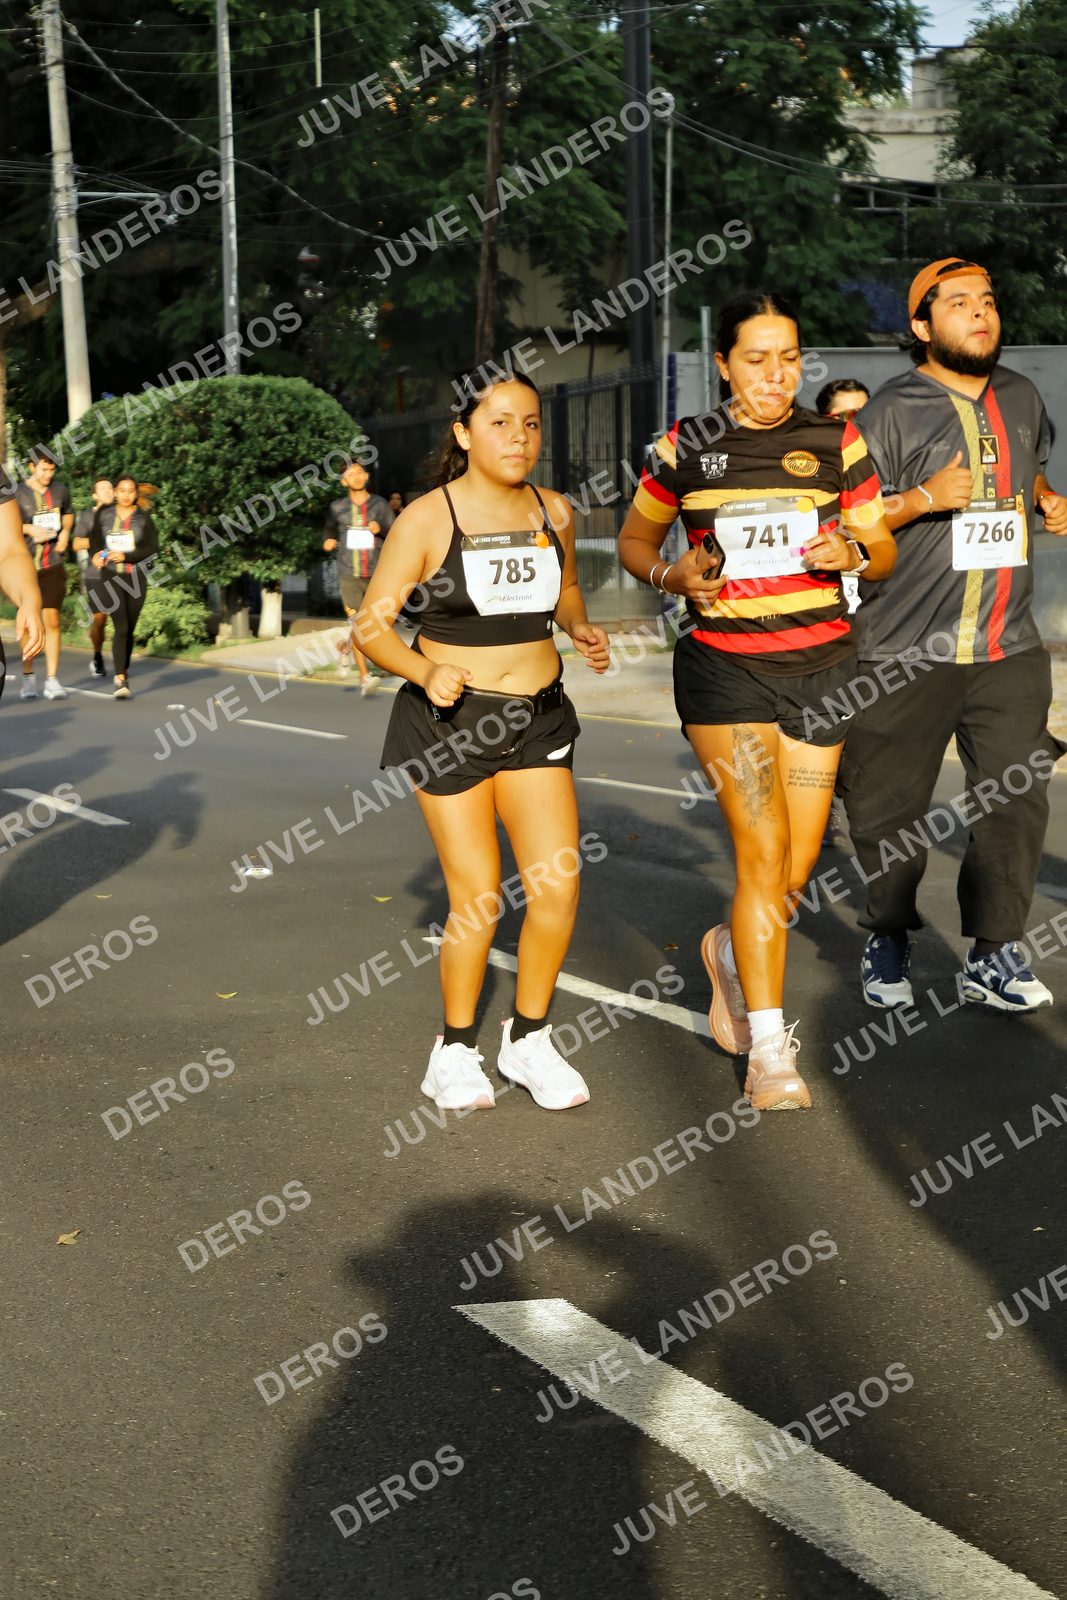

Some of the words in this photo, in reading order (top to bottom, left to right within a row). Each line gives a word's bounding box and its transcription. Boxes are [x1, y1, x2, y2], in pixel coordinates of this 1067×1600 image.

[742, 523, 790, 549] 741
[964, 520, 1015, 545] 7266
[489, 557, 536, 585] 785
